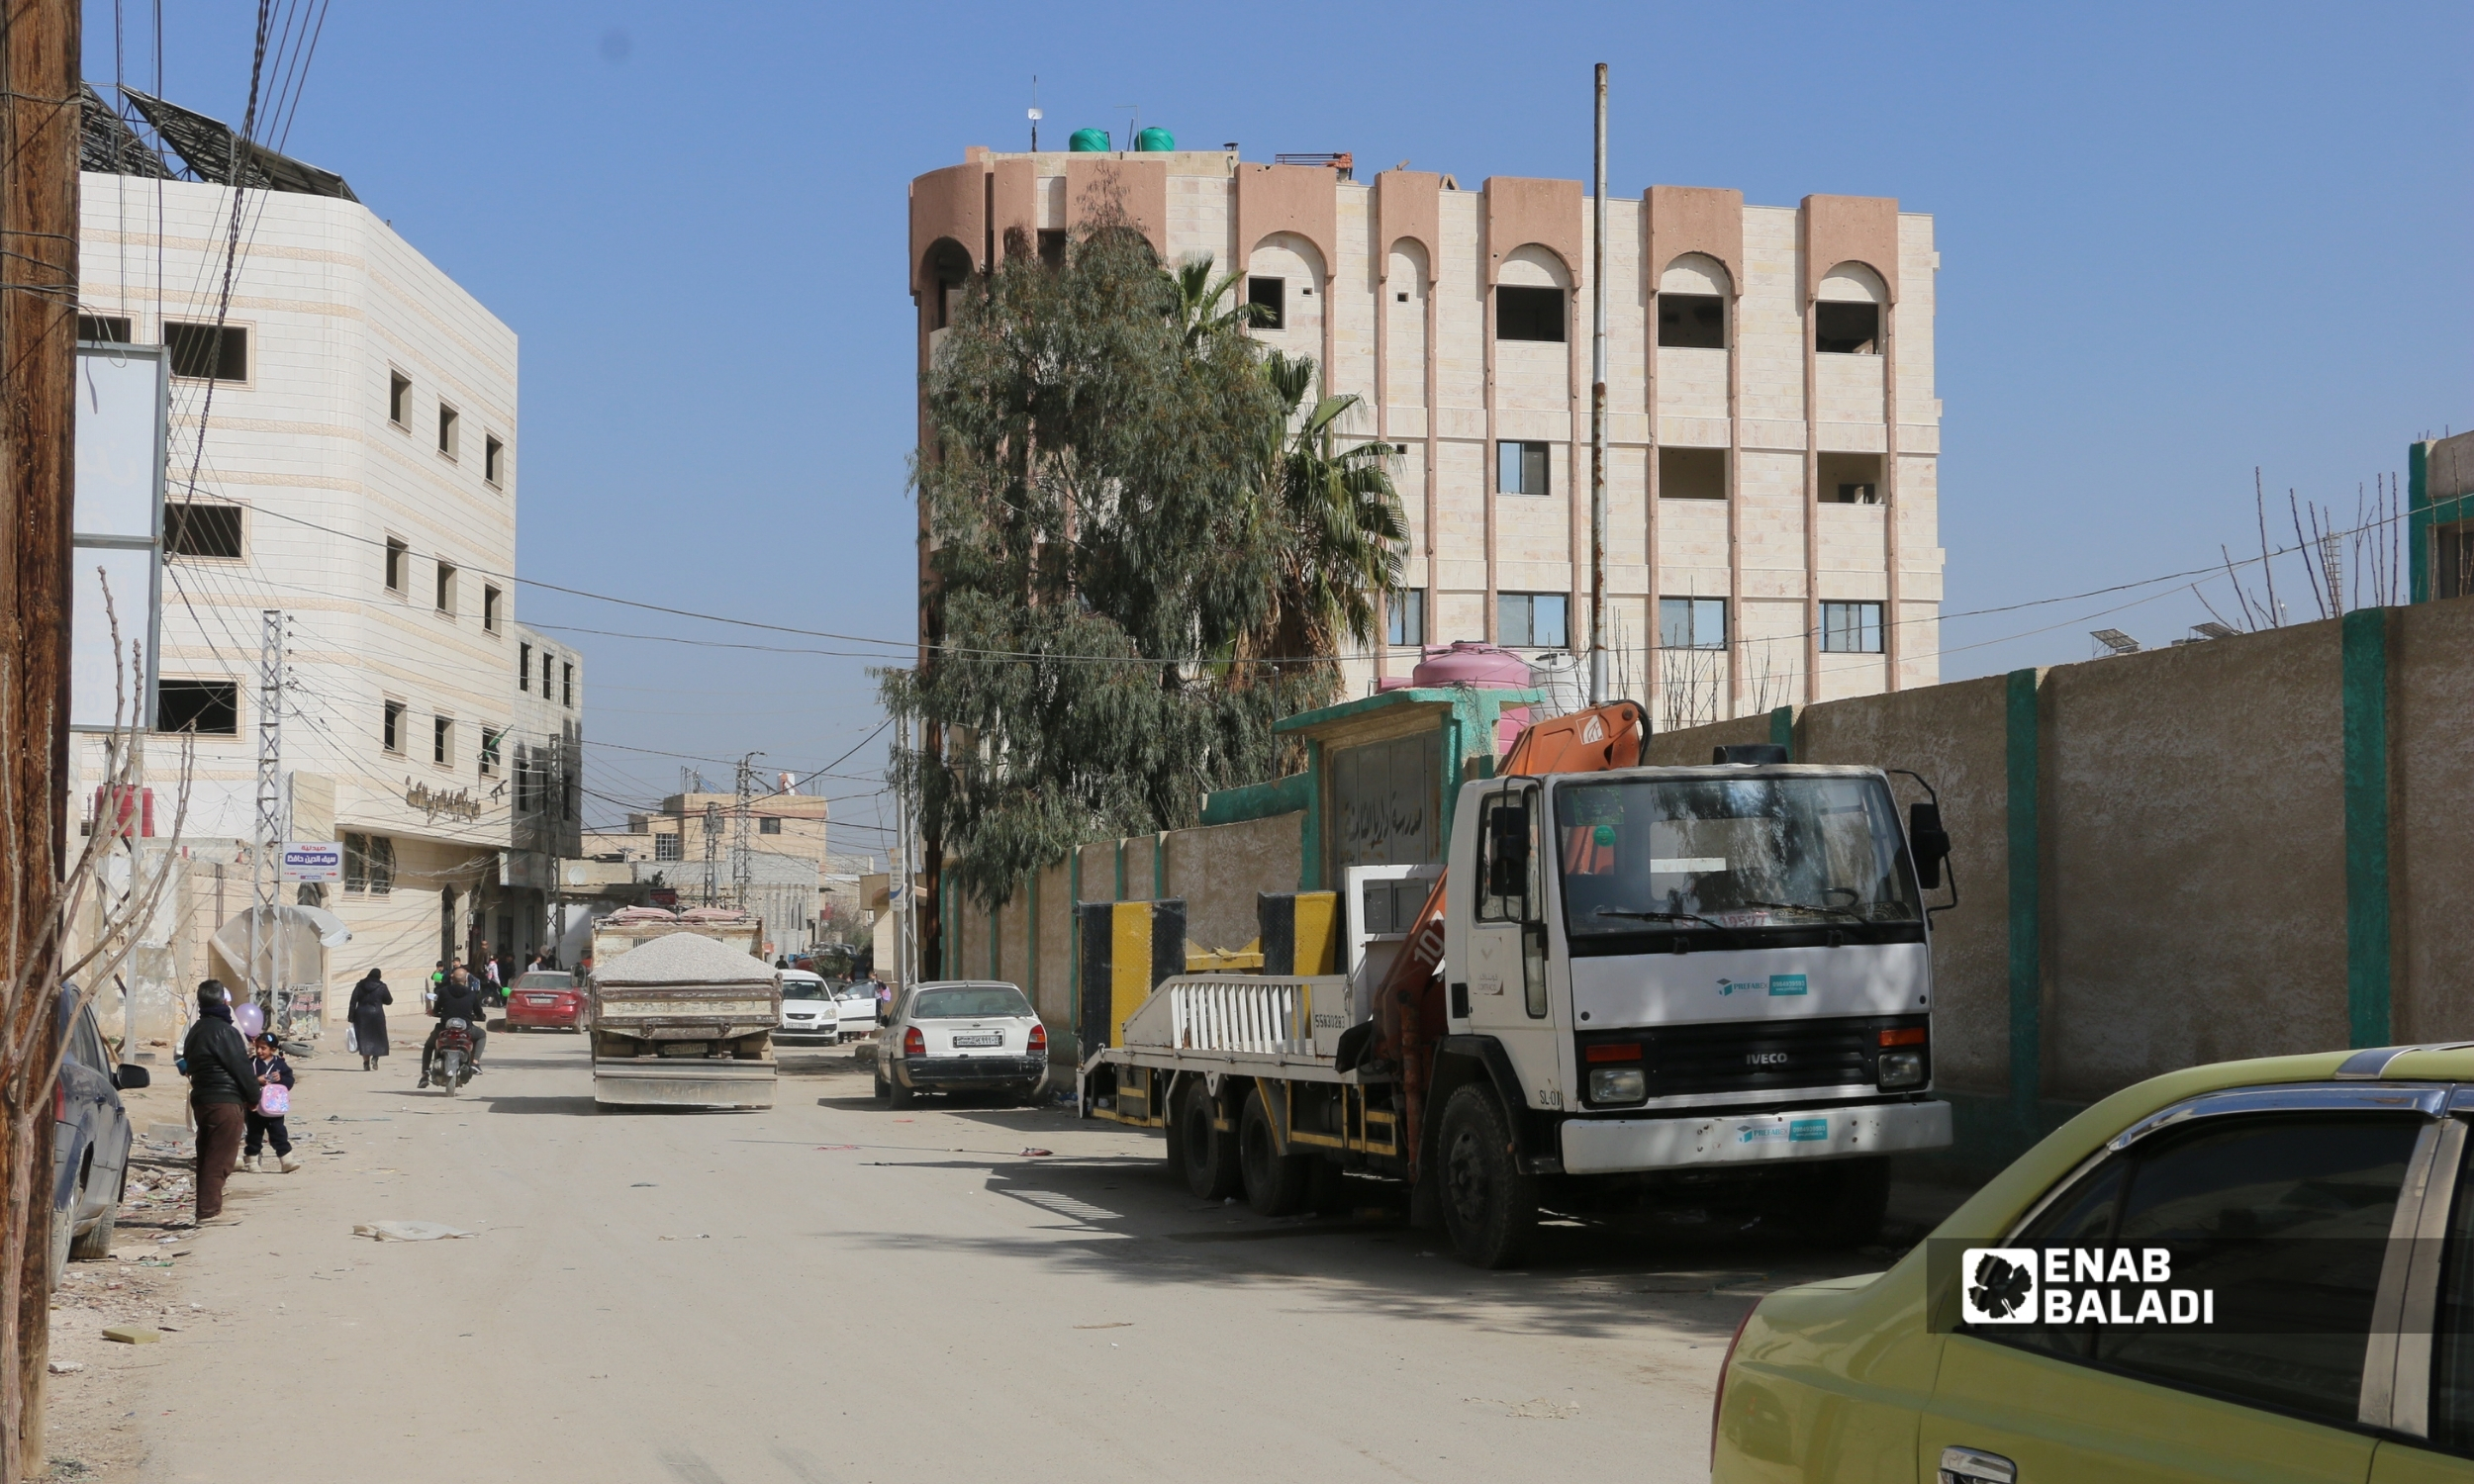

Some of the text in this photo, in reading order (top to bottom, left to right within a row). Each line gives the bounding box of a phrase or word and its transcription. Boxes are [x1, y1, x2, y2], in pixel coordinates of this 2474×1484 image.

[305, 855, 321, 864] الدين
[322, 855, 336, 864] سيف
[1746, 1053, 1788, 1065] IVECO
